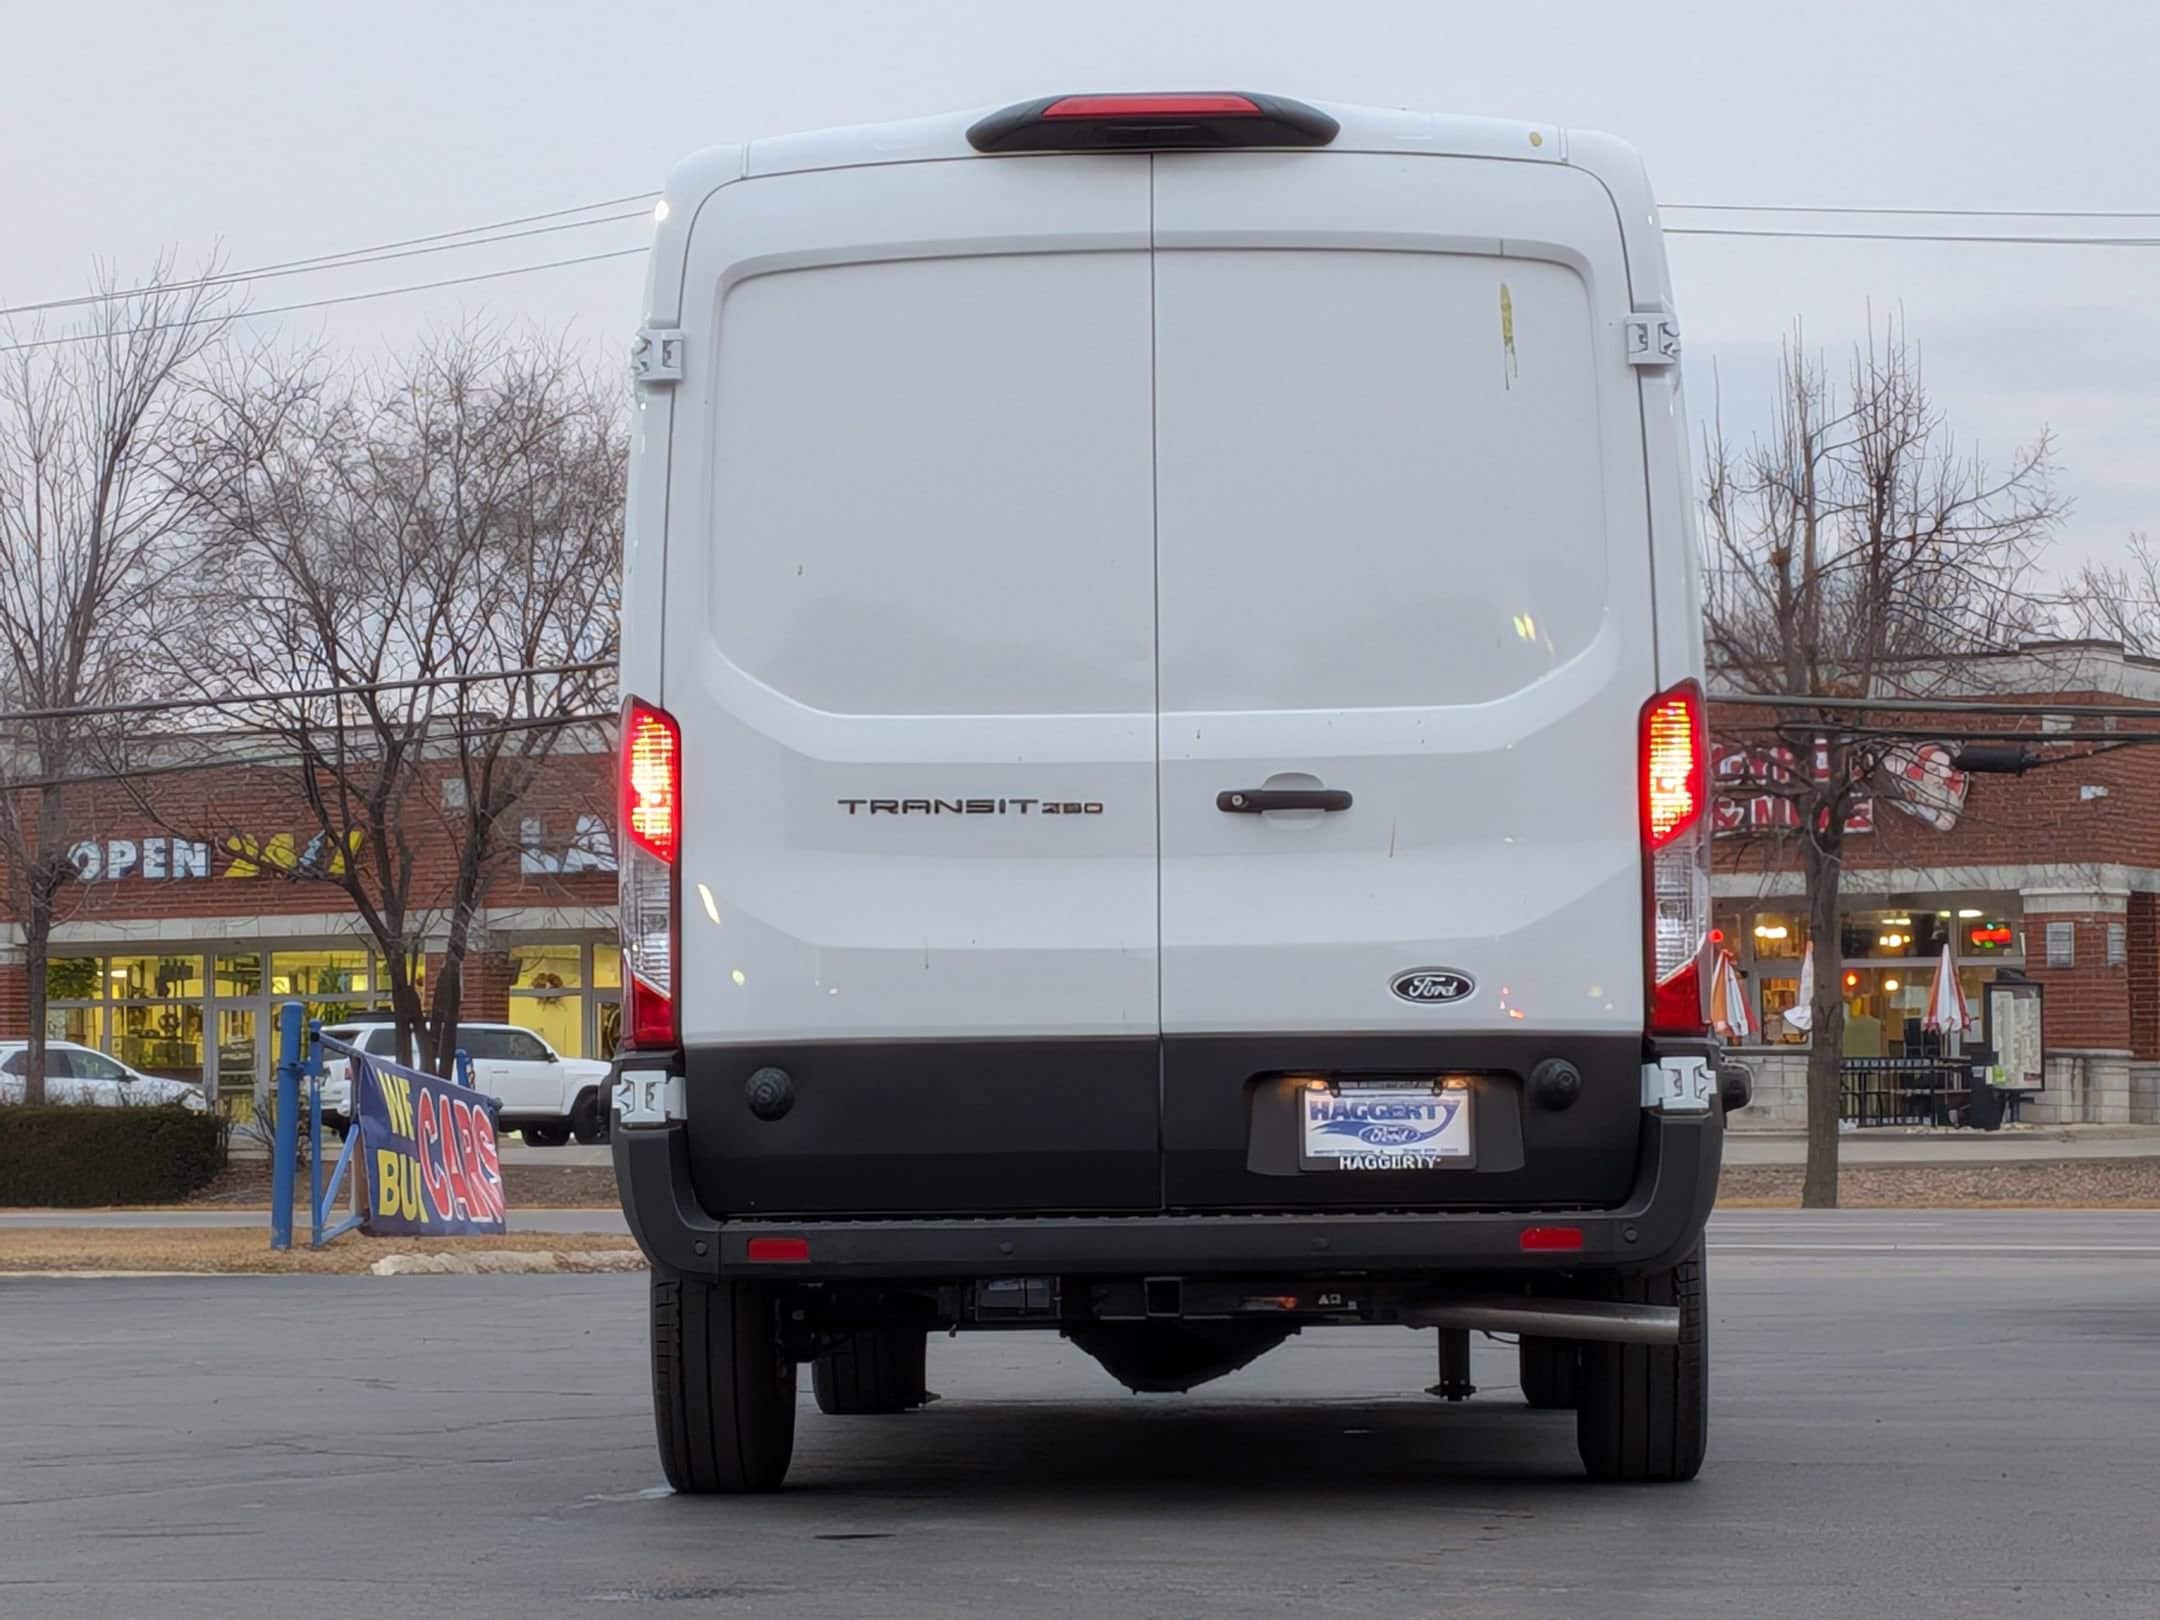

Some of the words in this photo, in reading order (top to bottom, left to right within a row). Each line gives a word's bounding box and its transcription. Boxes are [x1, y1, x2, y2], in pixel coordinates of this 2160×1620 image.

[838, 800, 1037, 814] TRANSIT
[67, 837, 208, 880] OPEN
[1408, 976, 1458, 996] Ford
[377, 1068, 415, 1141] WE
[417, 1088, 503, 1223] CARS
